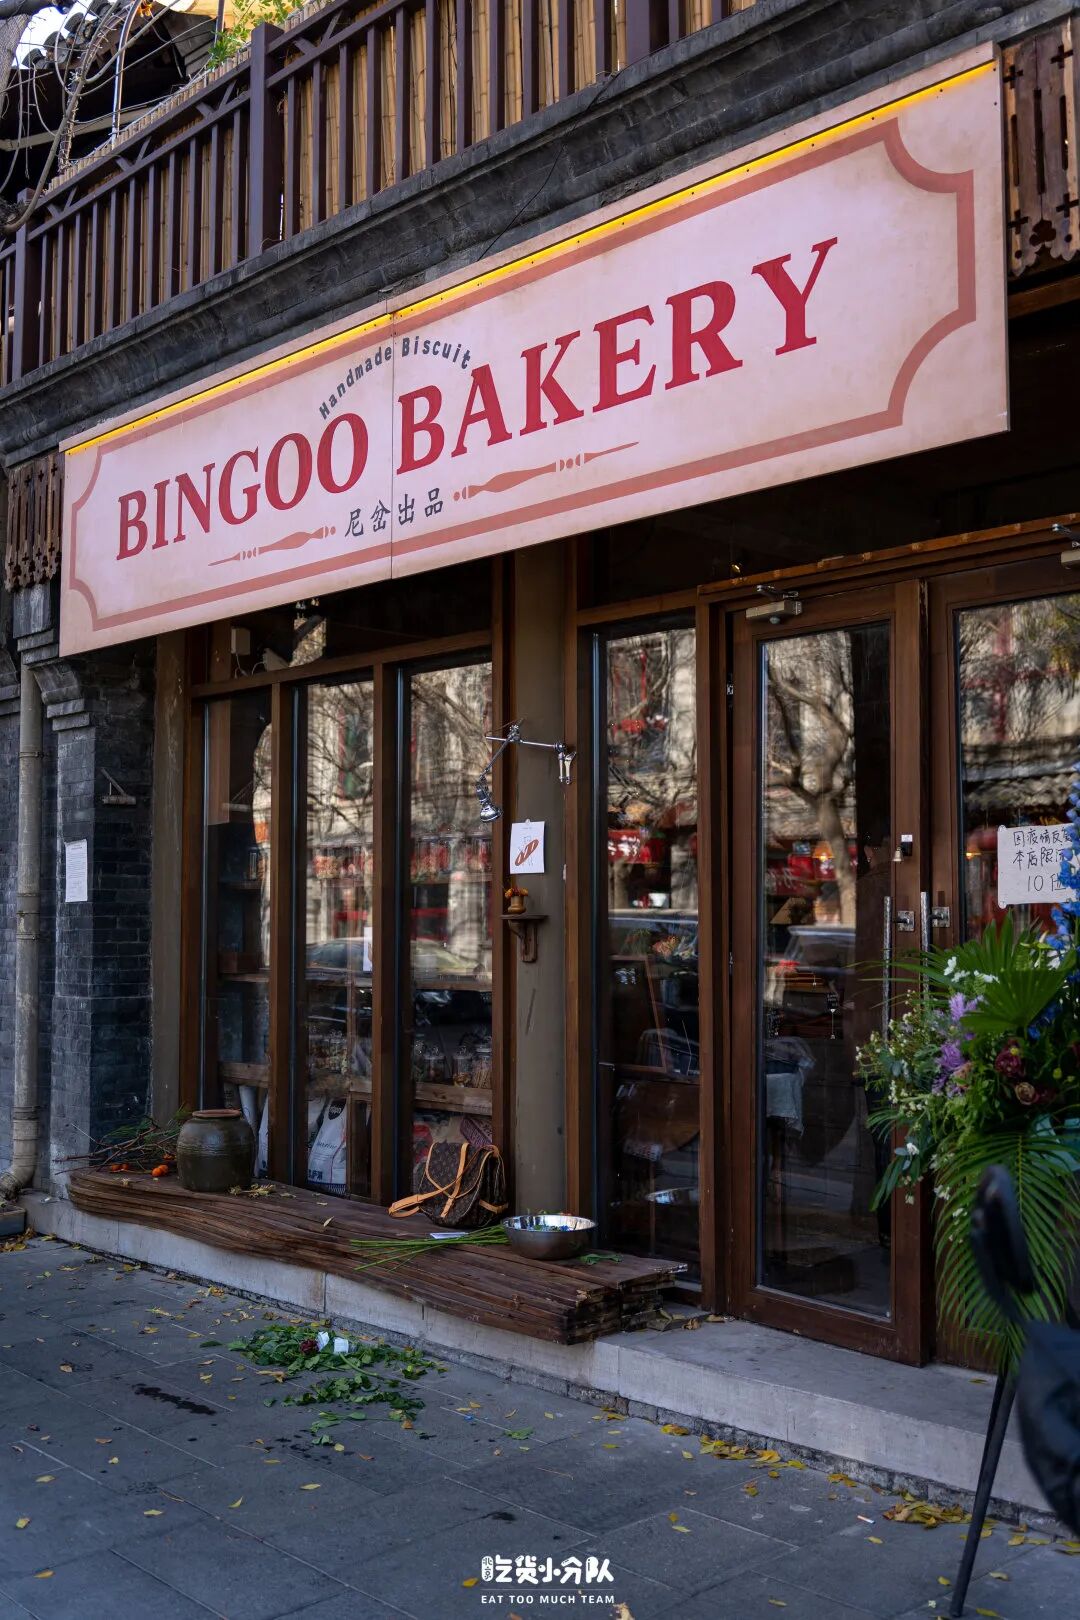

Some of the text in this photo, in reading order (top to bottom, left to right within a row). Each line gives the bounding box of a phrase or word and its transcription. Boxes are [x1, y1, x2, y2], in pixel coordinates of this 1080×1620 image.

[116, 237, 838, 561] BINGOO BAKERY
[319, 336, 471, 419] Handmade Biscuit
[345, 487, 443, 537] 尼岔出品
